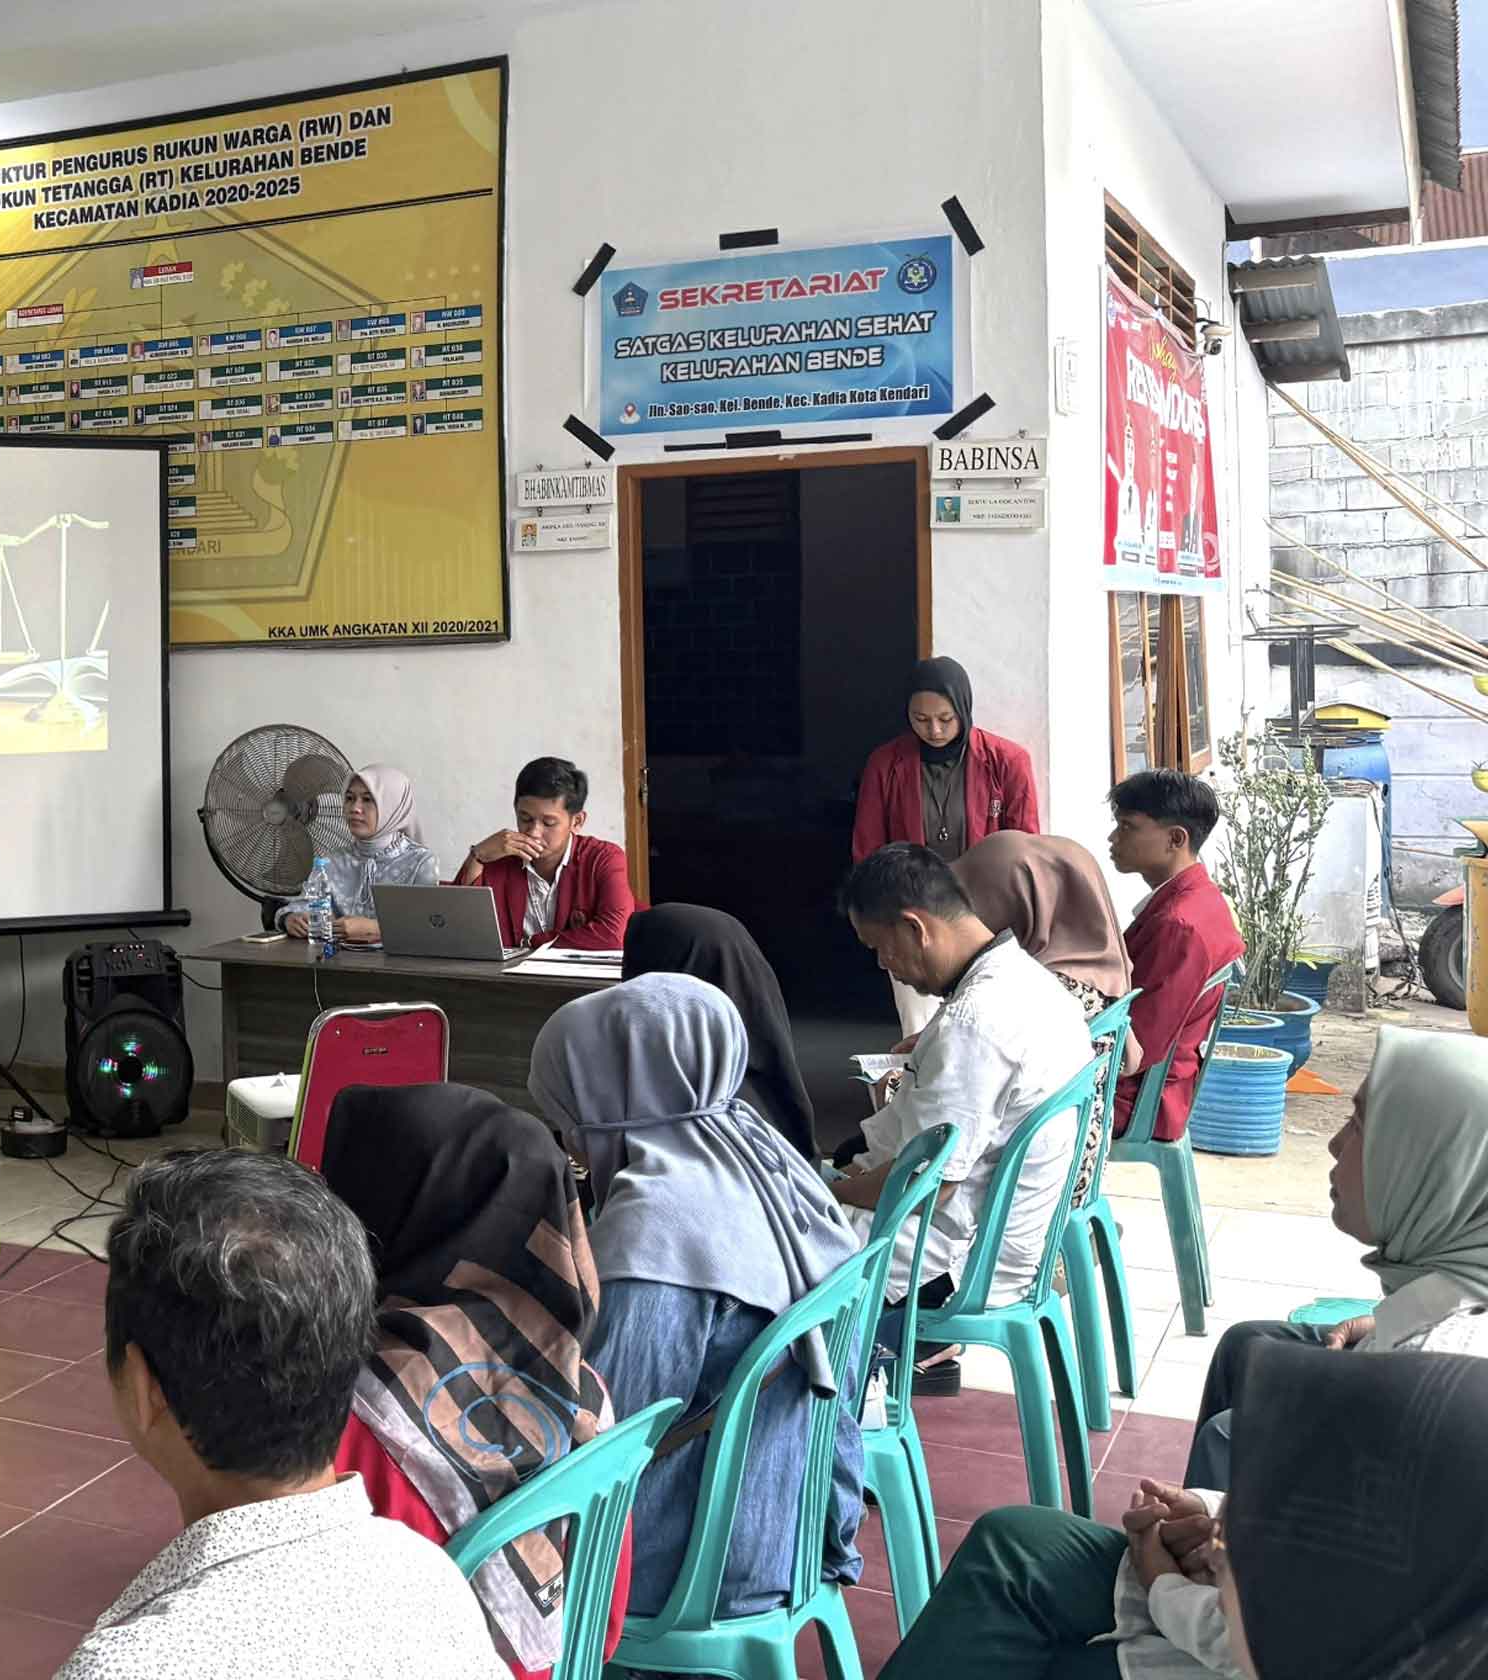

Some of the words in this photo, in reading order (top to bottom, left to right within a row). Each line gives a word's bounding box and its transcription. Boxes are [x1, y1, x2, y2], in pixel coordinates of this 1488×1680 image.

[51, 146, 149, 178] PENGURUS
[153, 135, 218, 162] RUKUN
[223, 122, 293, 151] WARGA
[297, 115, 344, 143] (RW)
[349, 106, 392, 131] DAN
[41, 175, 134, 204] TETANGGA
[139, 170, 175, 194] (RT)
[180, 149, 294, 185] KELURAHAN
[300, 138, 368, 167] BENDE
[33, 200, 139, 231] KECAMATAN
[144, 190, 201, 216] KADIA
[204, 175, 301, 206] 2020-2025
[658, 268, 888, 312] SEKRETARIAT
[615, 332, 704, 359] SATGAS
[709, 318, 852, 351] KELURAHAN
[856, 311, 937, 338] SEHAT
[661, 352, 801, 384] KELURAHAN
[806, 346, 884, 372] BENDE
[813, 391, 848, 406] Kadia
[850, 388, 878, 403] Kota
[879, 385, 930, 402] Kendari
[938, 446, 1041, 471] BABINSA
[268, 625, 297, 639] KKA
[299, 624, 329, 638] UMK
[332, 622, 408, 637] ANGKATAN
[411, 621, 428, 634] XII
[432, 619, 500, 634] 2020/2021
